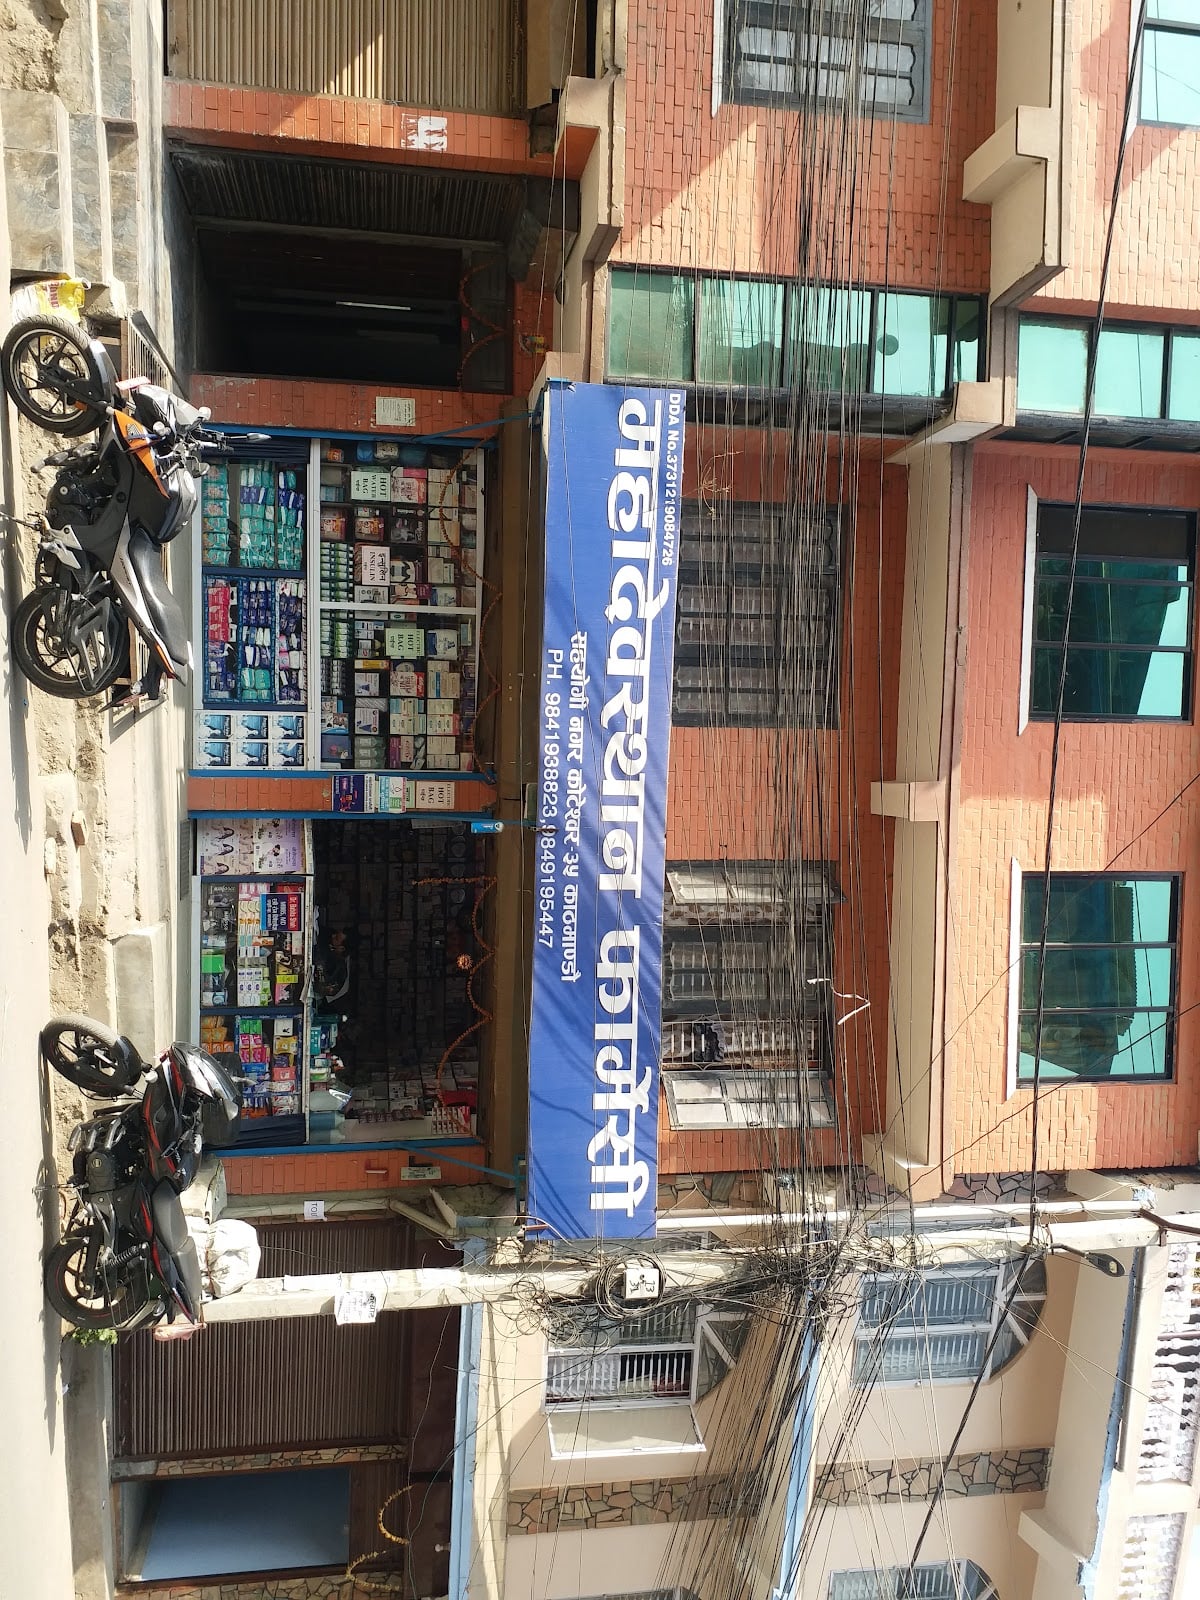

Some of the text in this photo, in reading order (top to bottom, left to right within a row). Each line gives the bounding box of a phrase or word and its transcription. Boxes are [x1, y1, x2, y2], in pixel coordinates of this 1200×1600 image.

[379, 477, 387, 498] HOT
[661, 393, 681, 566] DDA No.3731219084726
[568, 631, 590, 711] सहयोगी
[567, 716, 584, 764] नगर
[437, 787, 445, 804] HOT
[538, 649, 563, 949] PH. 9841938823,9849195447
[587, 398, 670, 1218] महादेवस्थान फार्मेसी
[561, 884, 581, 982] काठमाण्डौ
